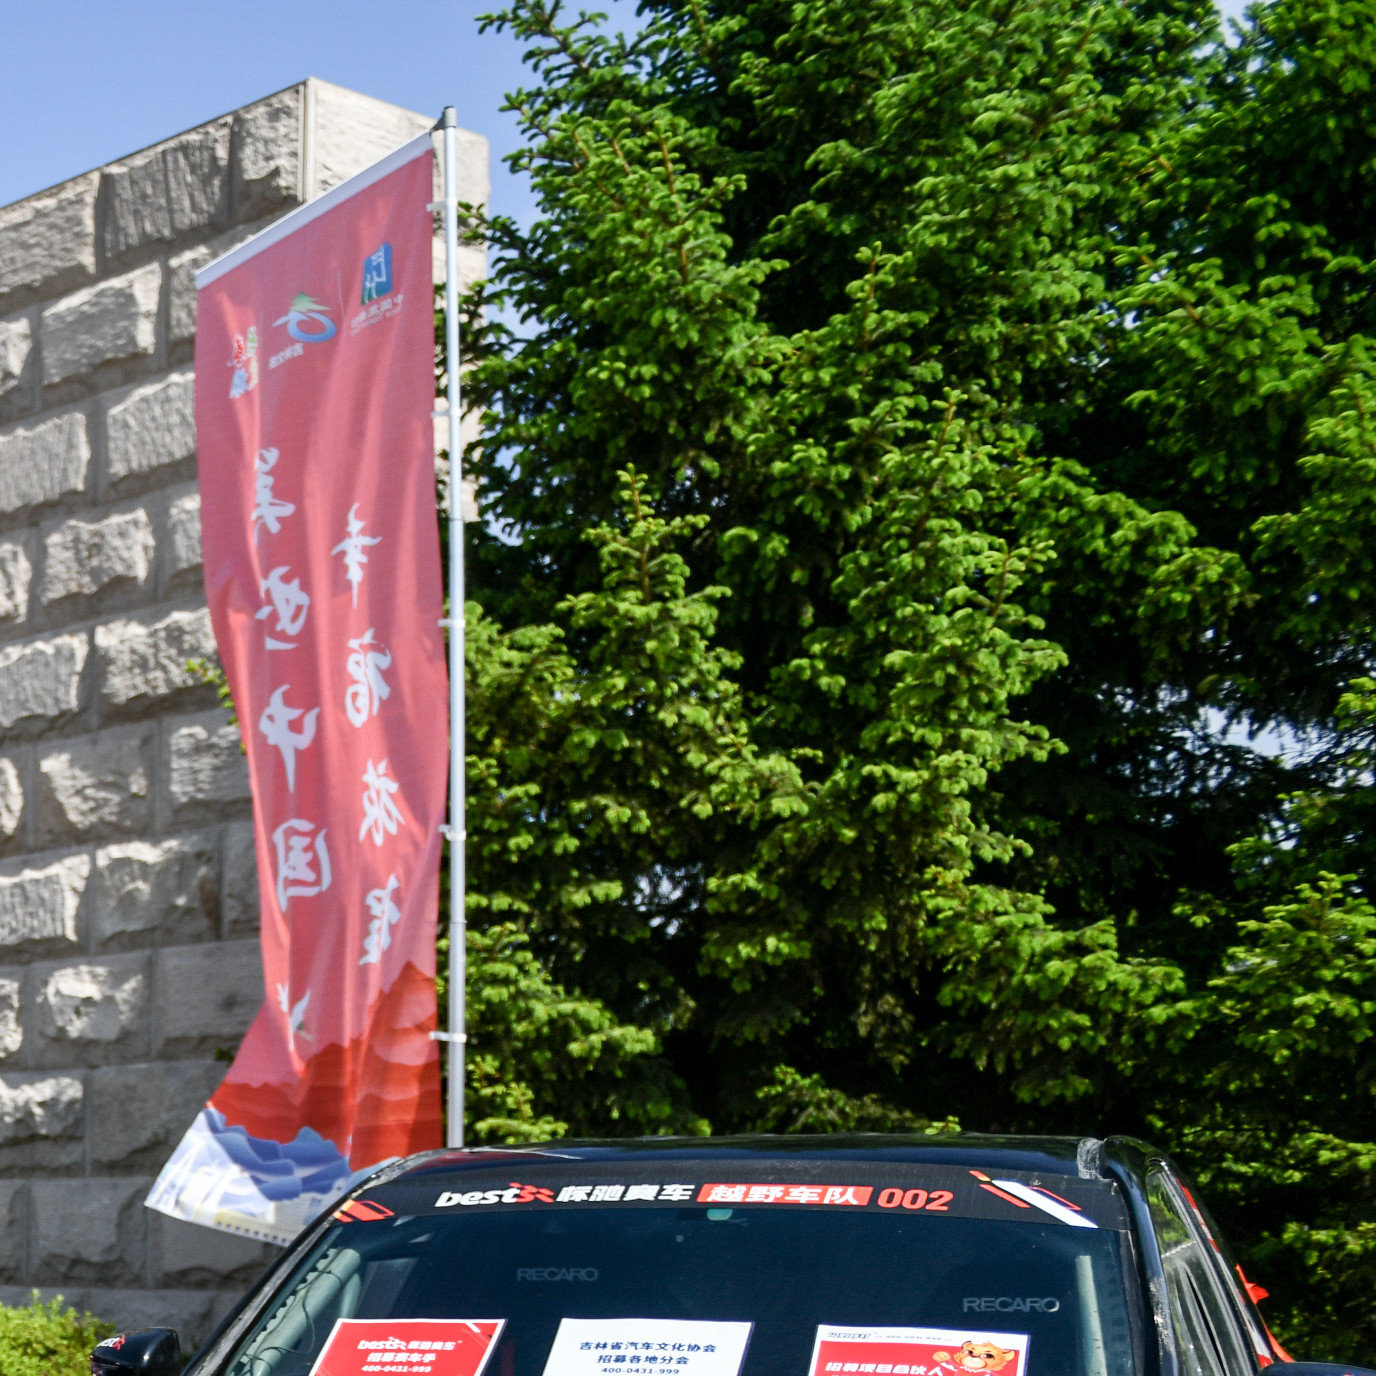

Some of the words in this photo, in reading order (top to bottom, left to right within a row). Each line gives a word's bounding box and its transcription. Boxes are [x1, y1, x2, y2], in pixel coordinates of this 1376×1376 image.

[708, 1185, 860, 1206] 越野车队
[877, 1188, 954, 1211] 002
[517, 1267, 598, 1282] RECARO
[962, 1297, 1060, 1313] RECARO
[579, 1341, 717, 1353] 吉林省汽车文化协会
[597, 1354, 690, 1365] 招募各地分会
[361, 1365, 432, 1373] 400-0431-999
[601, 1367, 680, 1375] 400-0431-999
[825, 1361, 944, 1376] 招募项目合伙人
